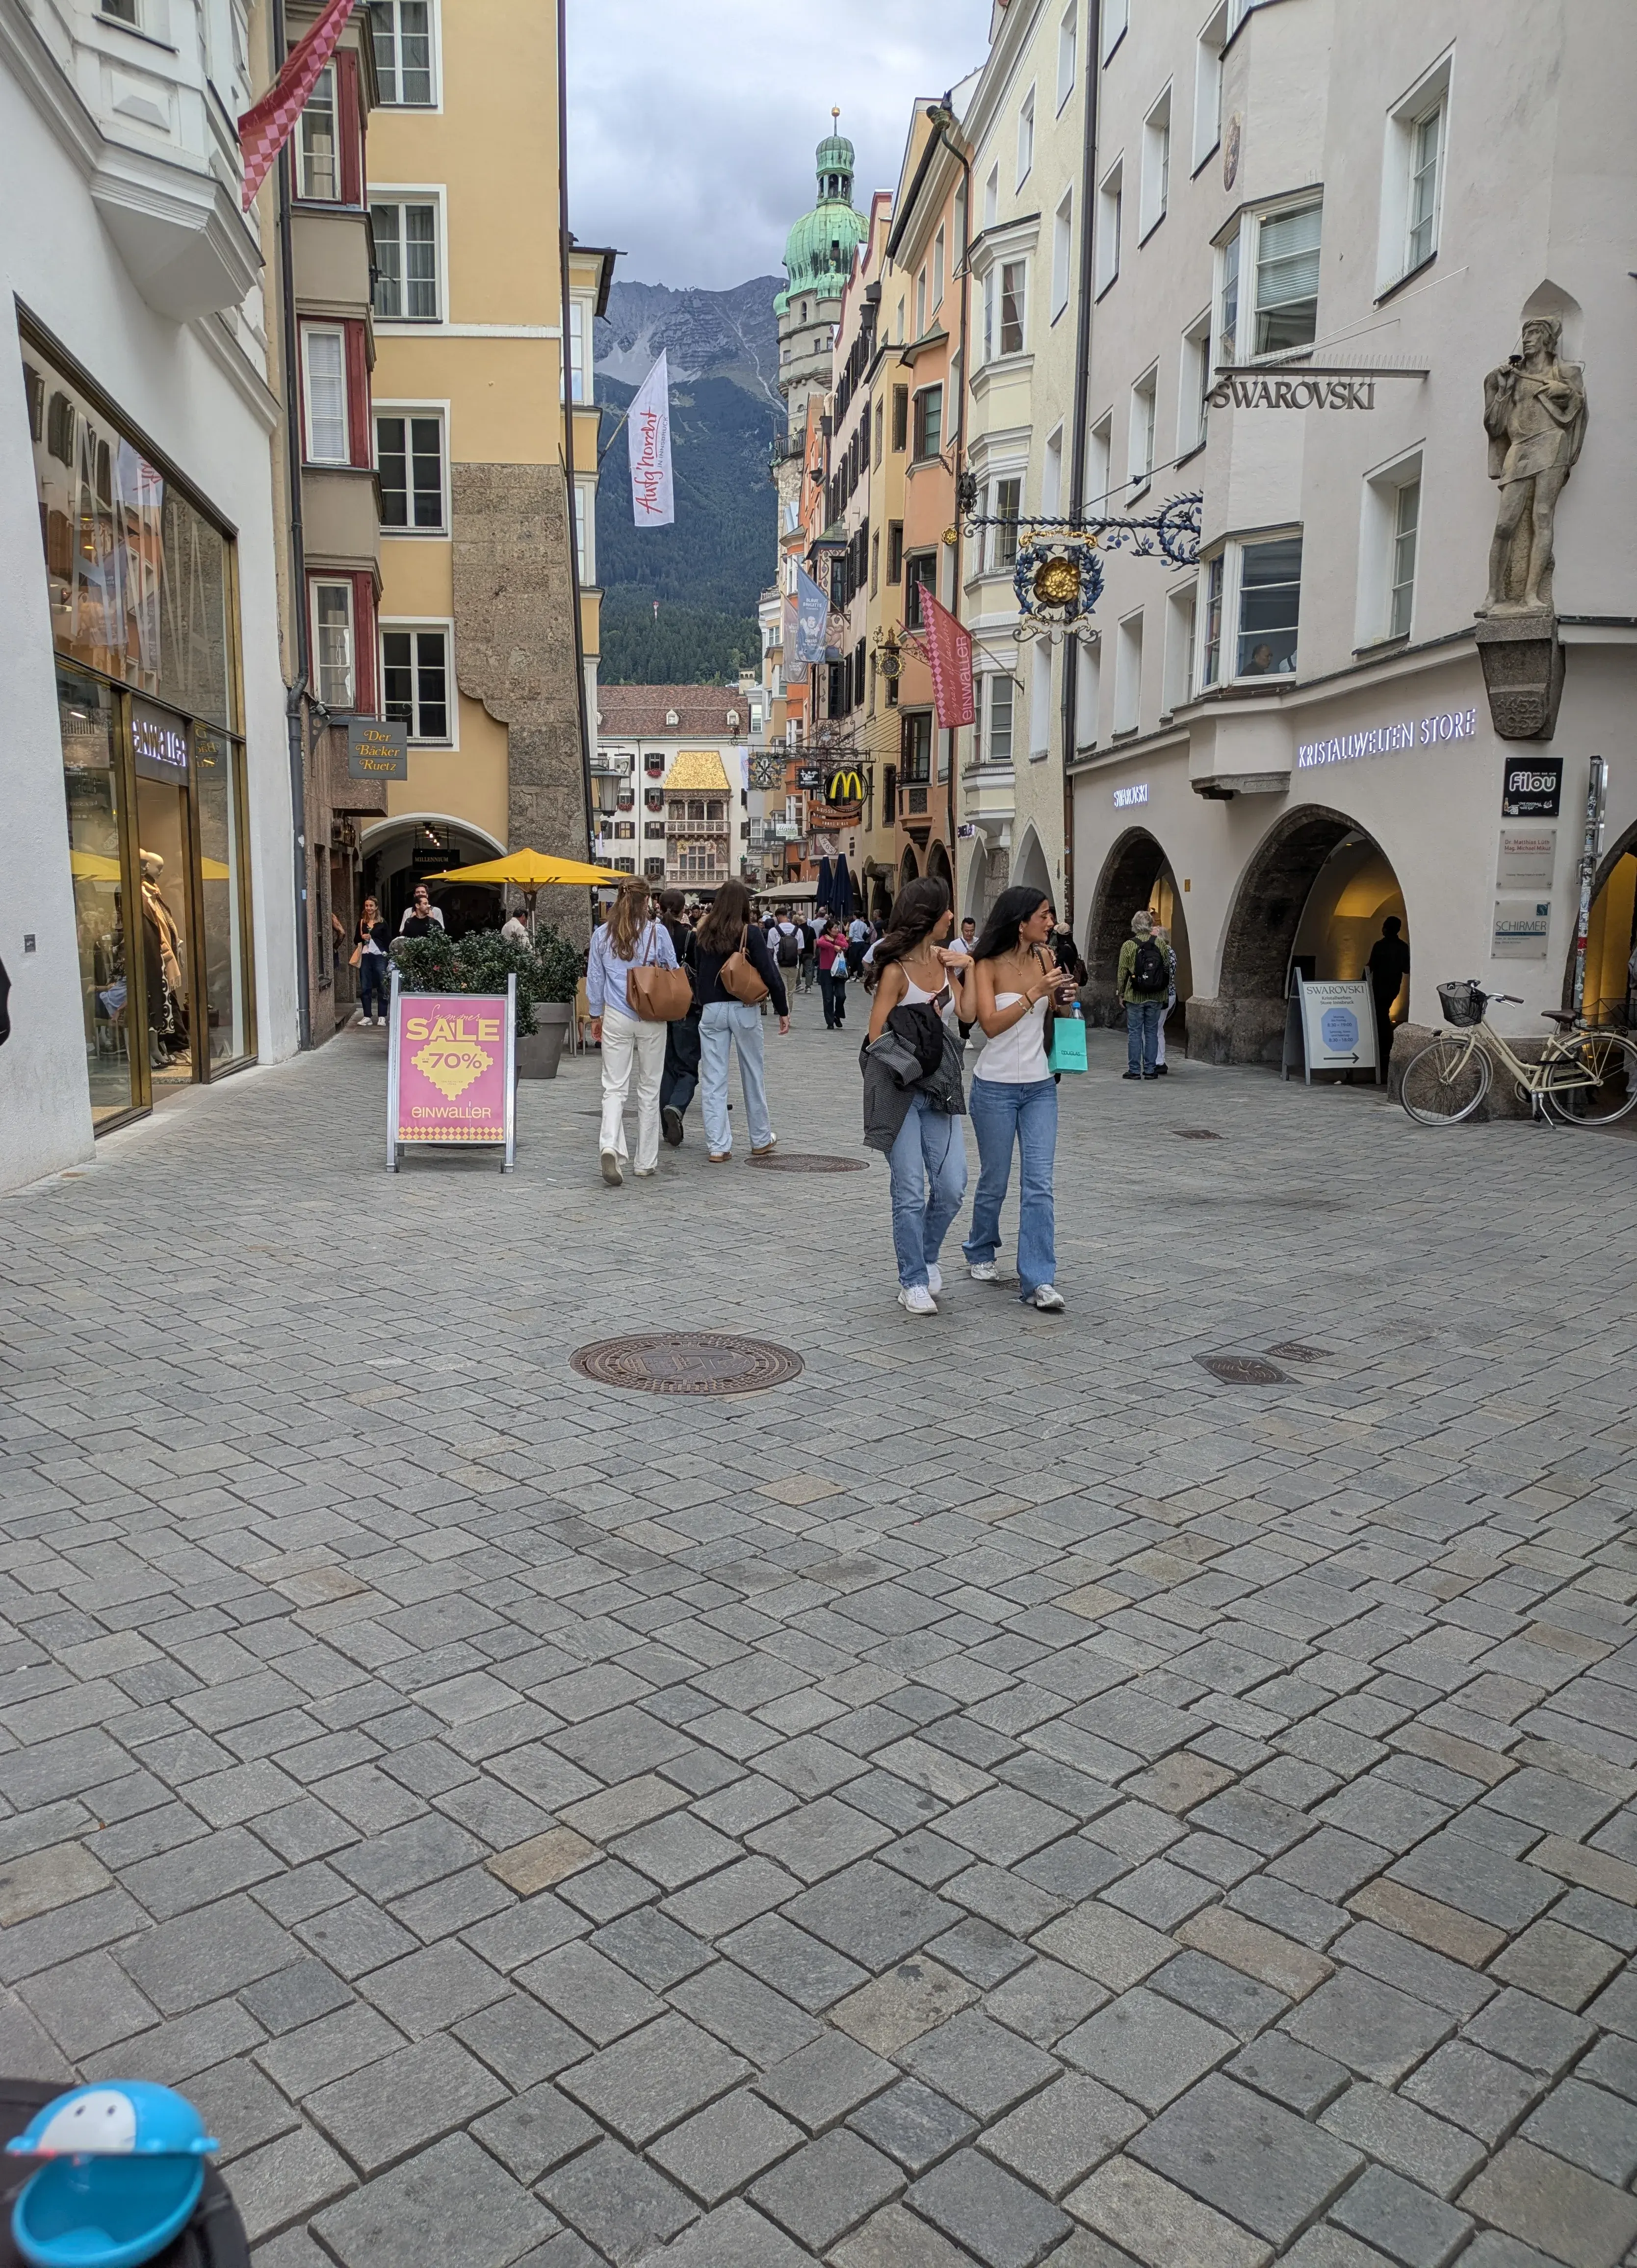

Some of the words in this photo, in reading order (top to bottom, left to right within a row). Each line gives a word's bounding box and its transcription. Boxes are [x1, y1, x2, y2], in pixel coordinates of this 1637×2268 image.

[1213, 381, 1376, 410] SWAROVSKI
[659, 417, 669, 459] INNSBRUCK
[364, 730, 391, 742] Der
[1299, 722, 1413, 768] KRISTALLWELTEN
[1420, 708, 1476, 745] STORE
[355, 744, 400, 756] Bäcker
[359, 759, 397, 771] Ruetz
[1509, 772, 1556, 792] Filou
[1114, 784, 1148, 807] SWAROVSKI
[820, 834, 834, 853] 1465
[1495, 921, 1547, 931] SCHIRMER
[1306, 985, 1364, 995] SWAROVSKI
[426, 1004, 483, 1023] Summer
[406, 1018, 499, 1041] SALE
